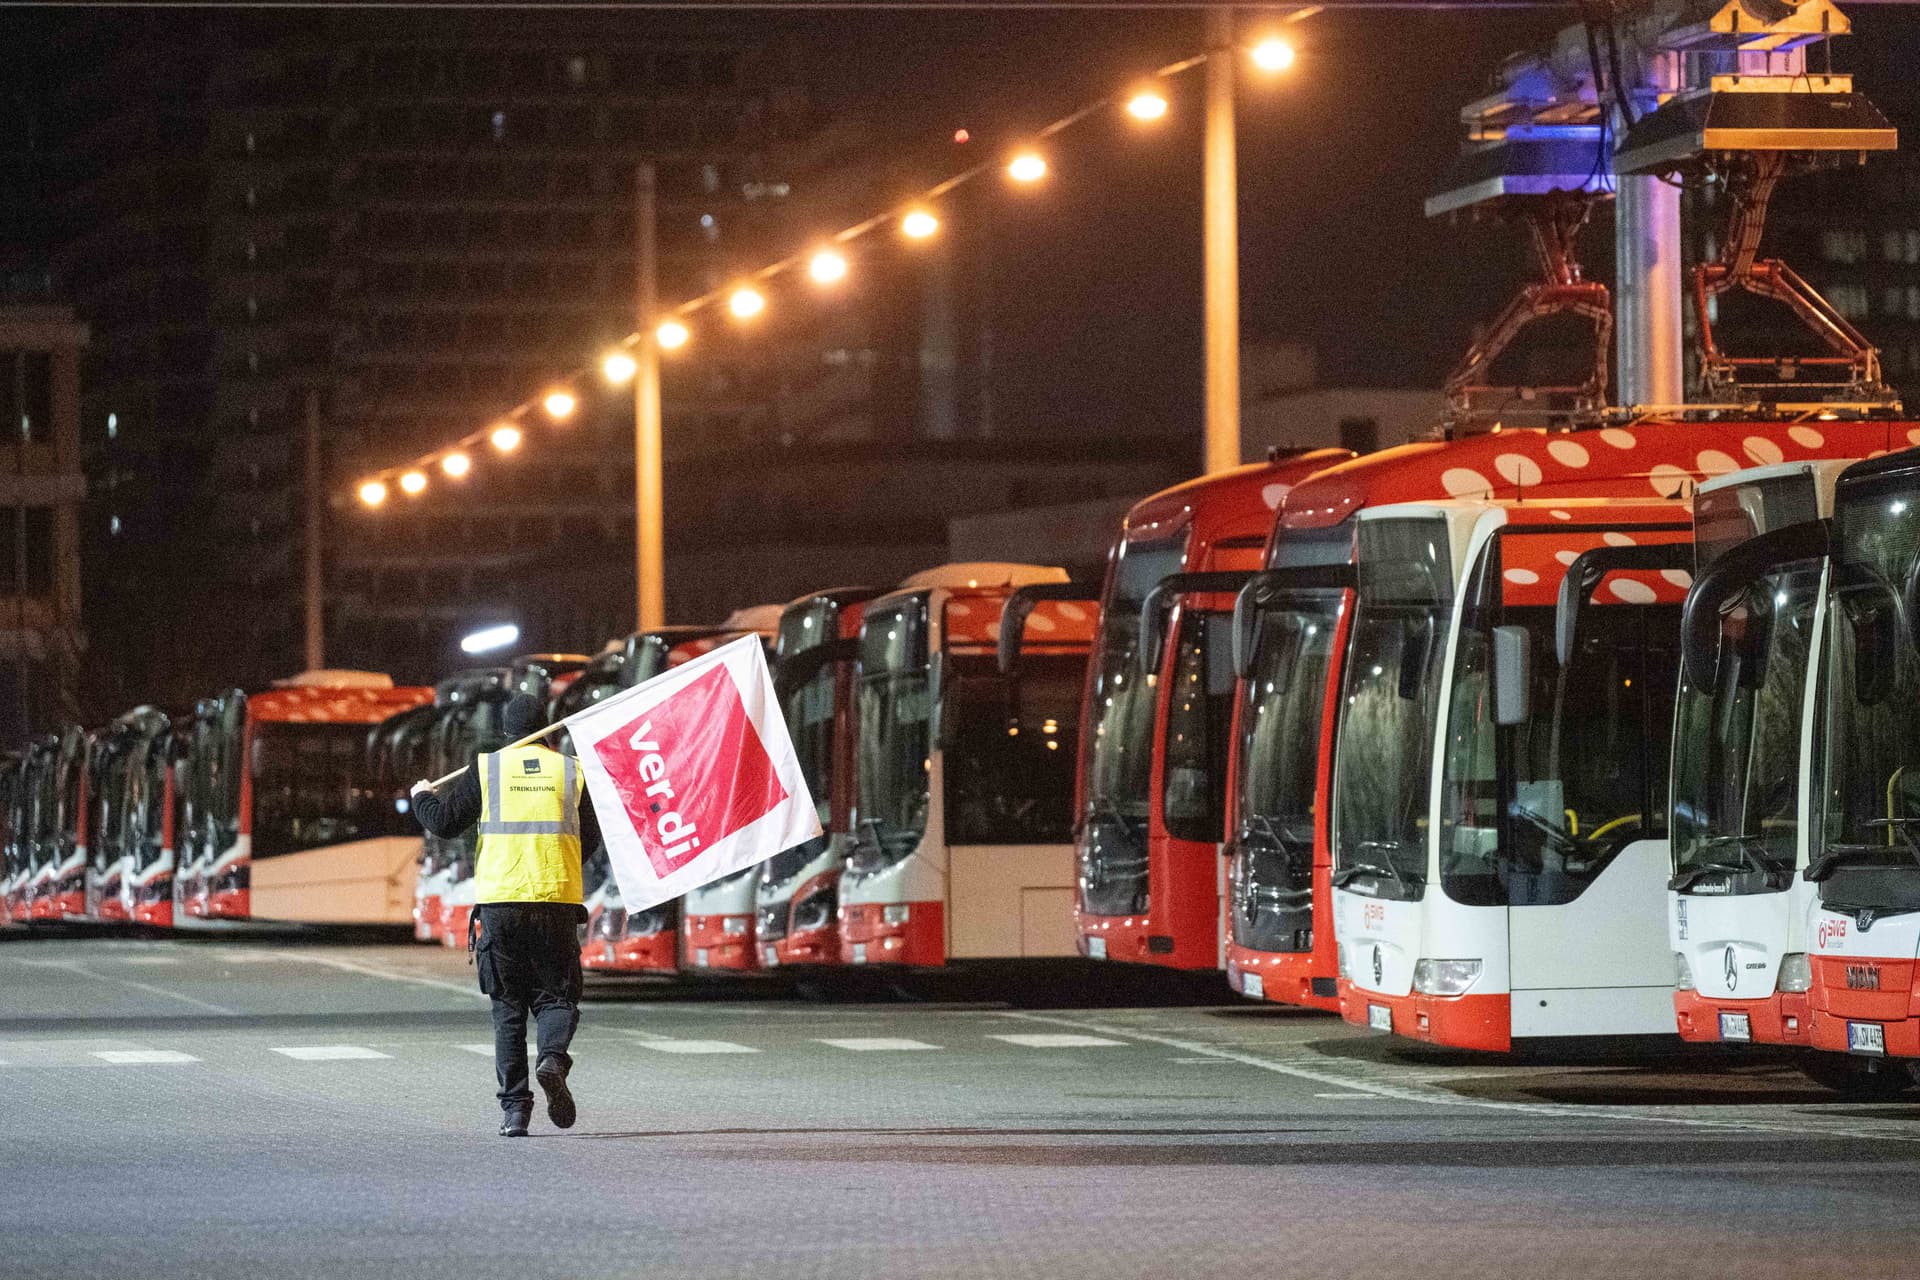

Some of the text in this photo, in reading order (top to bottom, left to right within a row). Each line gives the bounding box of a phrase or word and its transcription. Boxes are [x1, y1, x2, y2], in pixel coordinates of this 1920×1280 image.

[629, 719, 701, 860] ver.di
[1828, 919, 1847, 937] SWB
[1846, 965, 1881, 990] MAN
